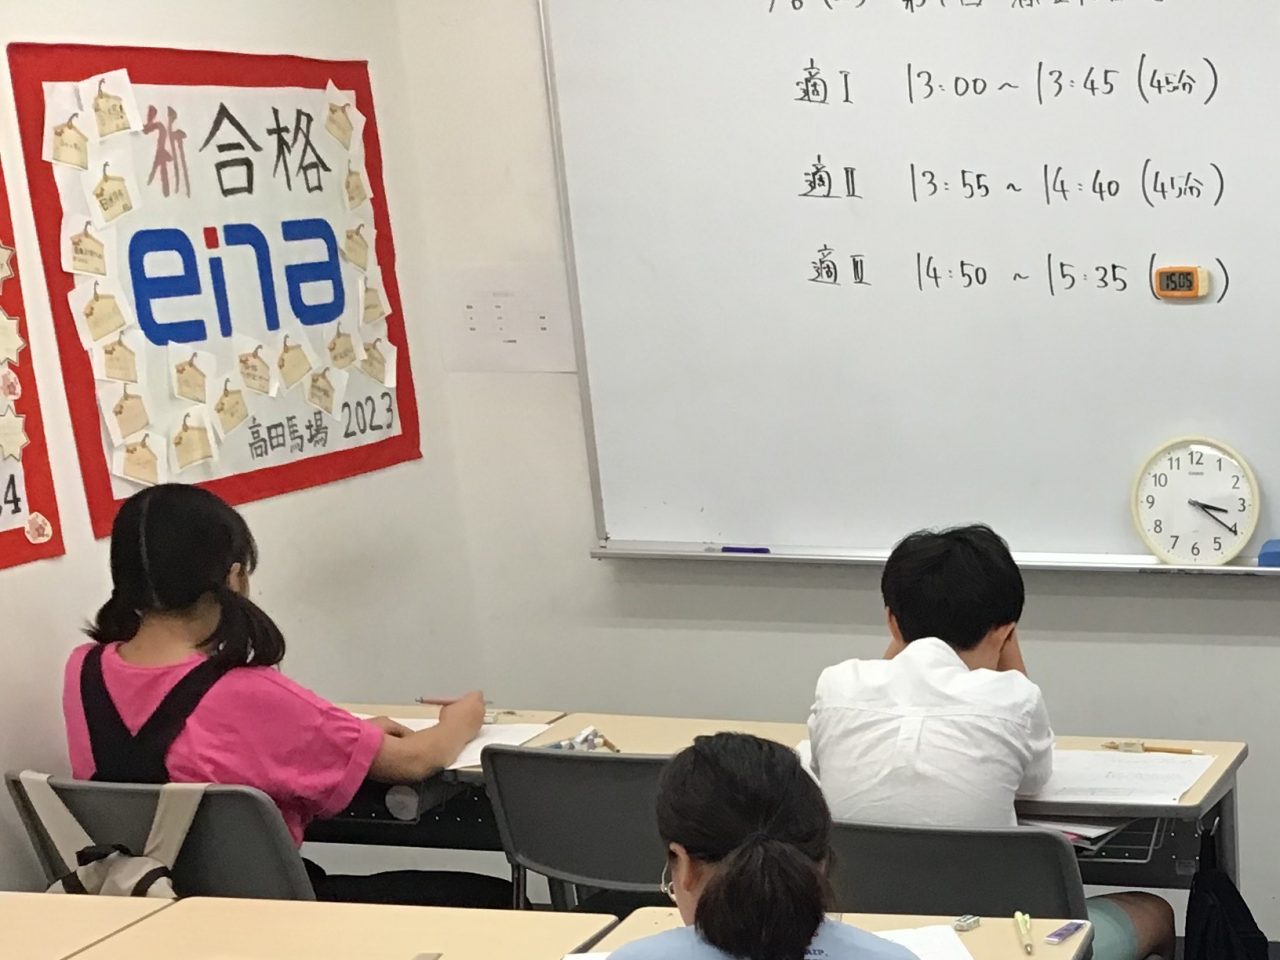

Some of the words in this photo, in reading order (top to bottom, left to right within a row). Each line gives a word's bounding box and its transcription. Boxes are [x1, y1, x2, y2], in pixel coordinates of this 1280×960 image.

[129, 217, 345, 346] ena
[248, 410, 329, 461] 高田馬場
[341, 391, 396, 439] 2023
[1168, 457, 1181, 470] 11
[1188, 451, 1204, 465] 12
[1152, 473, 1168, 487] 10
[1231, 475, 1240, 489] 2
[1146, 495, 1155, 509] 9
[1238, 498, 1246, 512] 3
[1153, 519, 1162, 533] 8
[1170, 535, 1179, 549] 7
[1191, 542, 1200, 556] 6
[1213, 537, 1222, 551] 5
